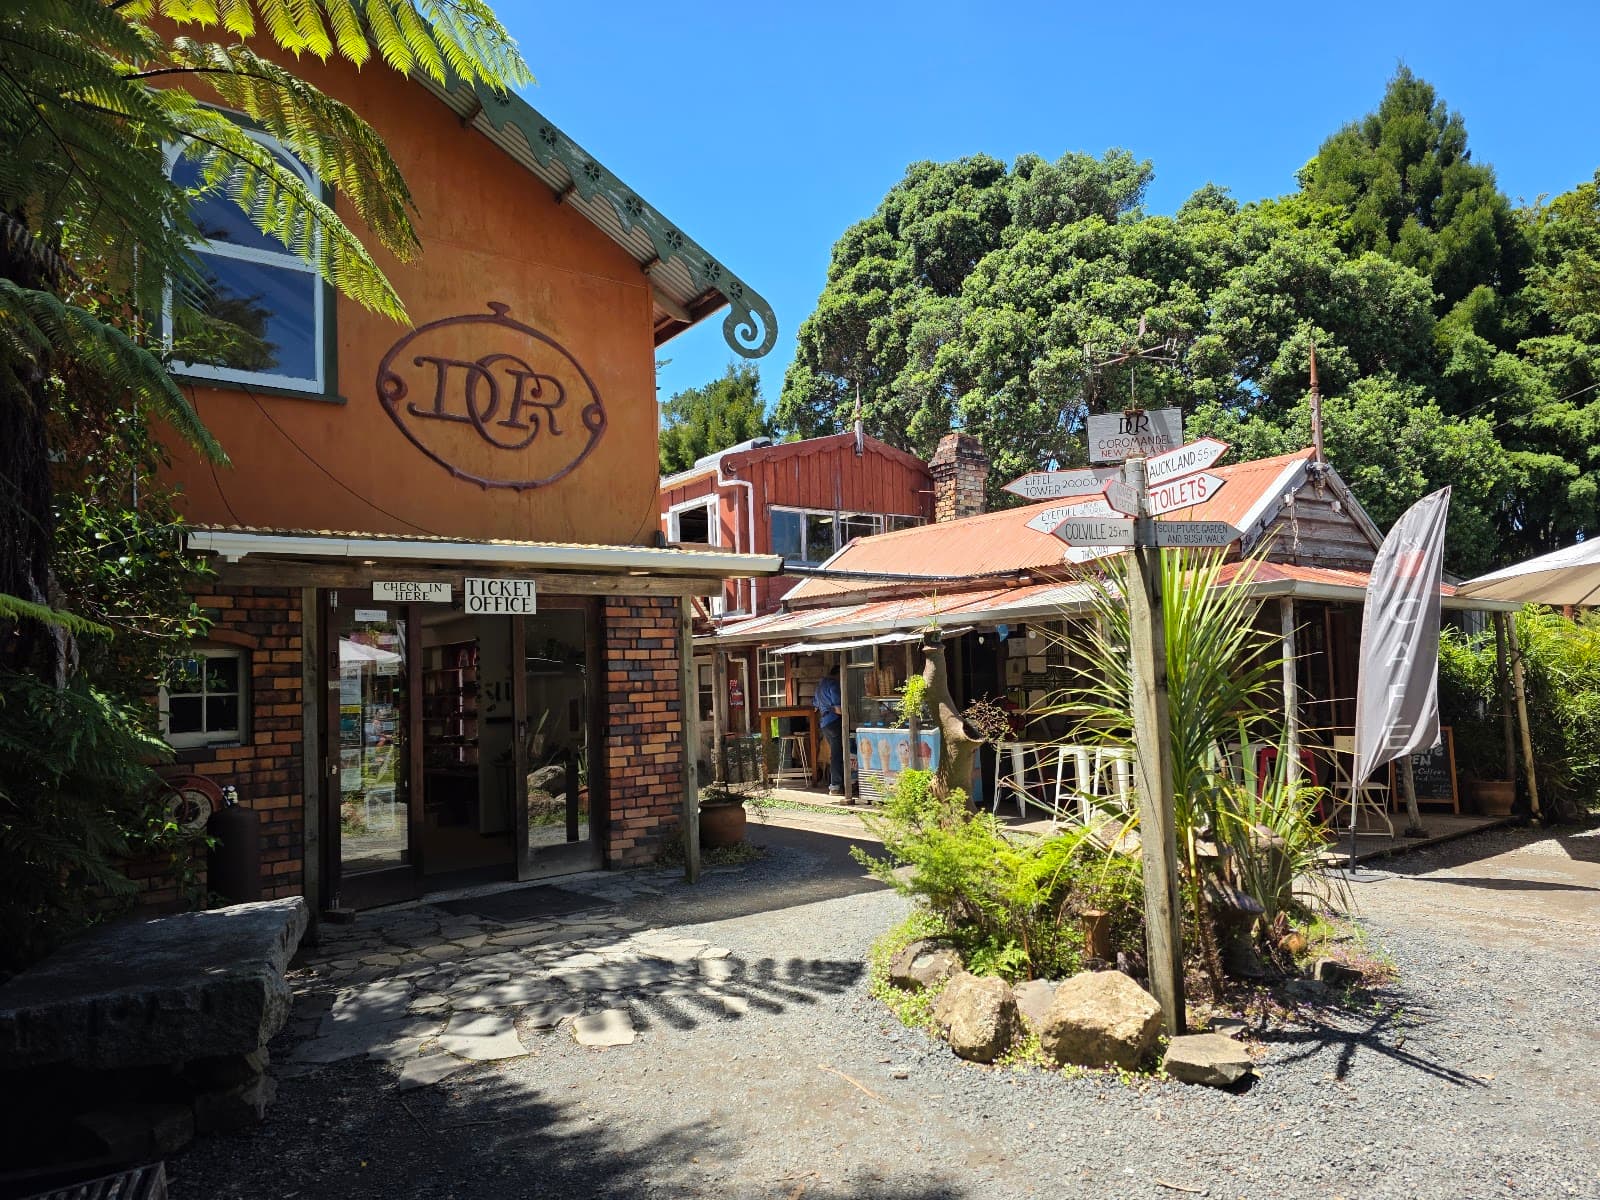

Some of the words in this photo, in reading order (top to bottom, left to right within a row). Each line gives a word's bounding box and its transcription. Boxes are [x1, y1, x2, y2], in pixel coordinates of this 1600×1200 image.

[1098, 434, 1173, 450] COROMANDEL
[1101, 449, 1122, 458] NEW
[1149, 452, 1196, 479] AUCKLAND
[1024, 485, 1061, 497] TOWER
[1151, 476, 1207, 509] TOILETS
[1065, 523, 1107, 540] COLVILLE
[1157, 524, 1200, 534] SCULPTURE
[1202, 524, 1228, 534] GARDEN
[1167, 534, 1182, 544] AND
[1184, 534, 1202, 544] BUSH
[1204, 533, 1226, 543] WALK
[383, 582, 421, 592] CHECK
[429, 583, 443, 592] IN
[466, 579, 534, 597] TICKET
[394, 591, 431, 601] HERE
[470, 596, 533, 612] OFFICE
